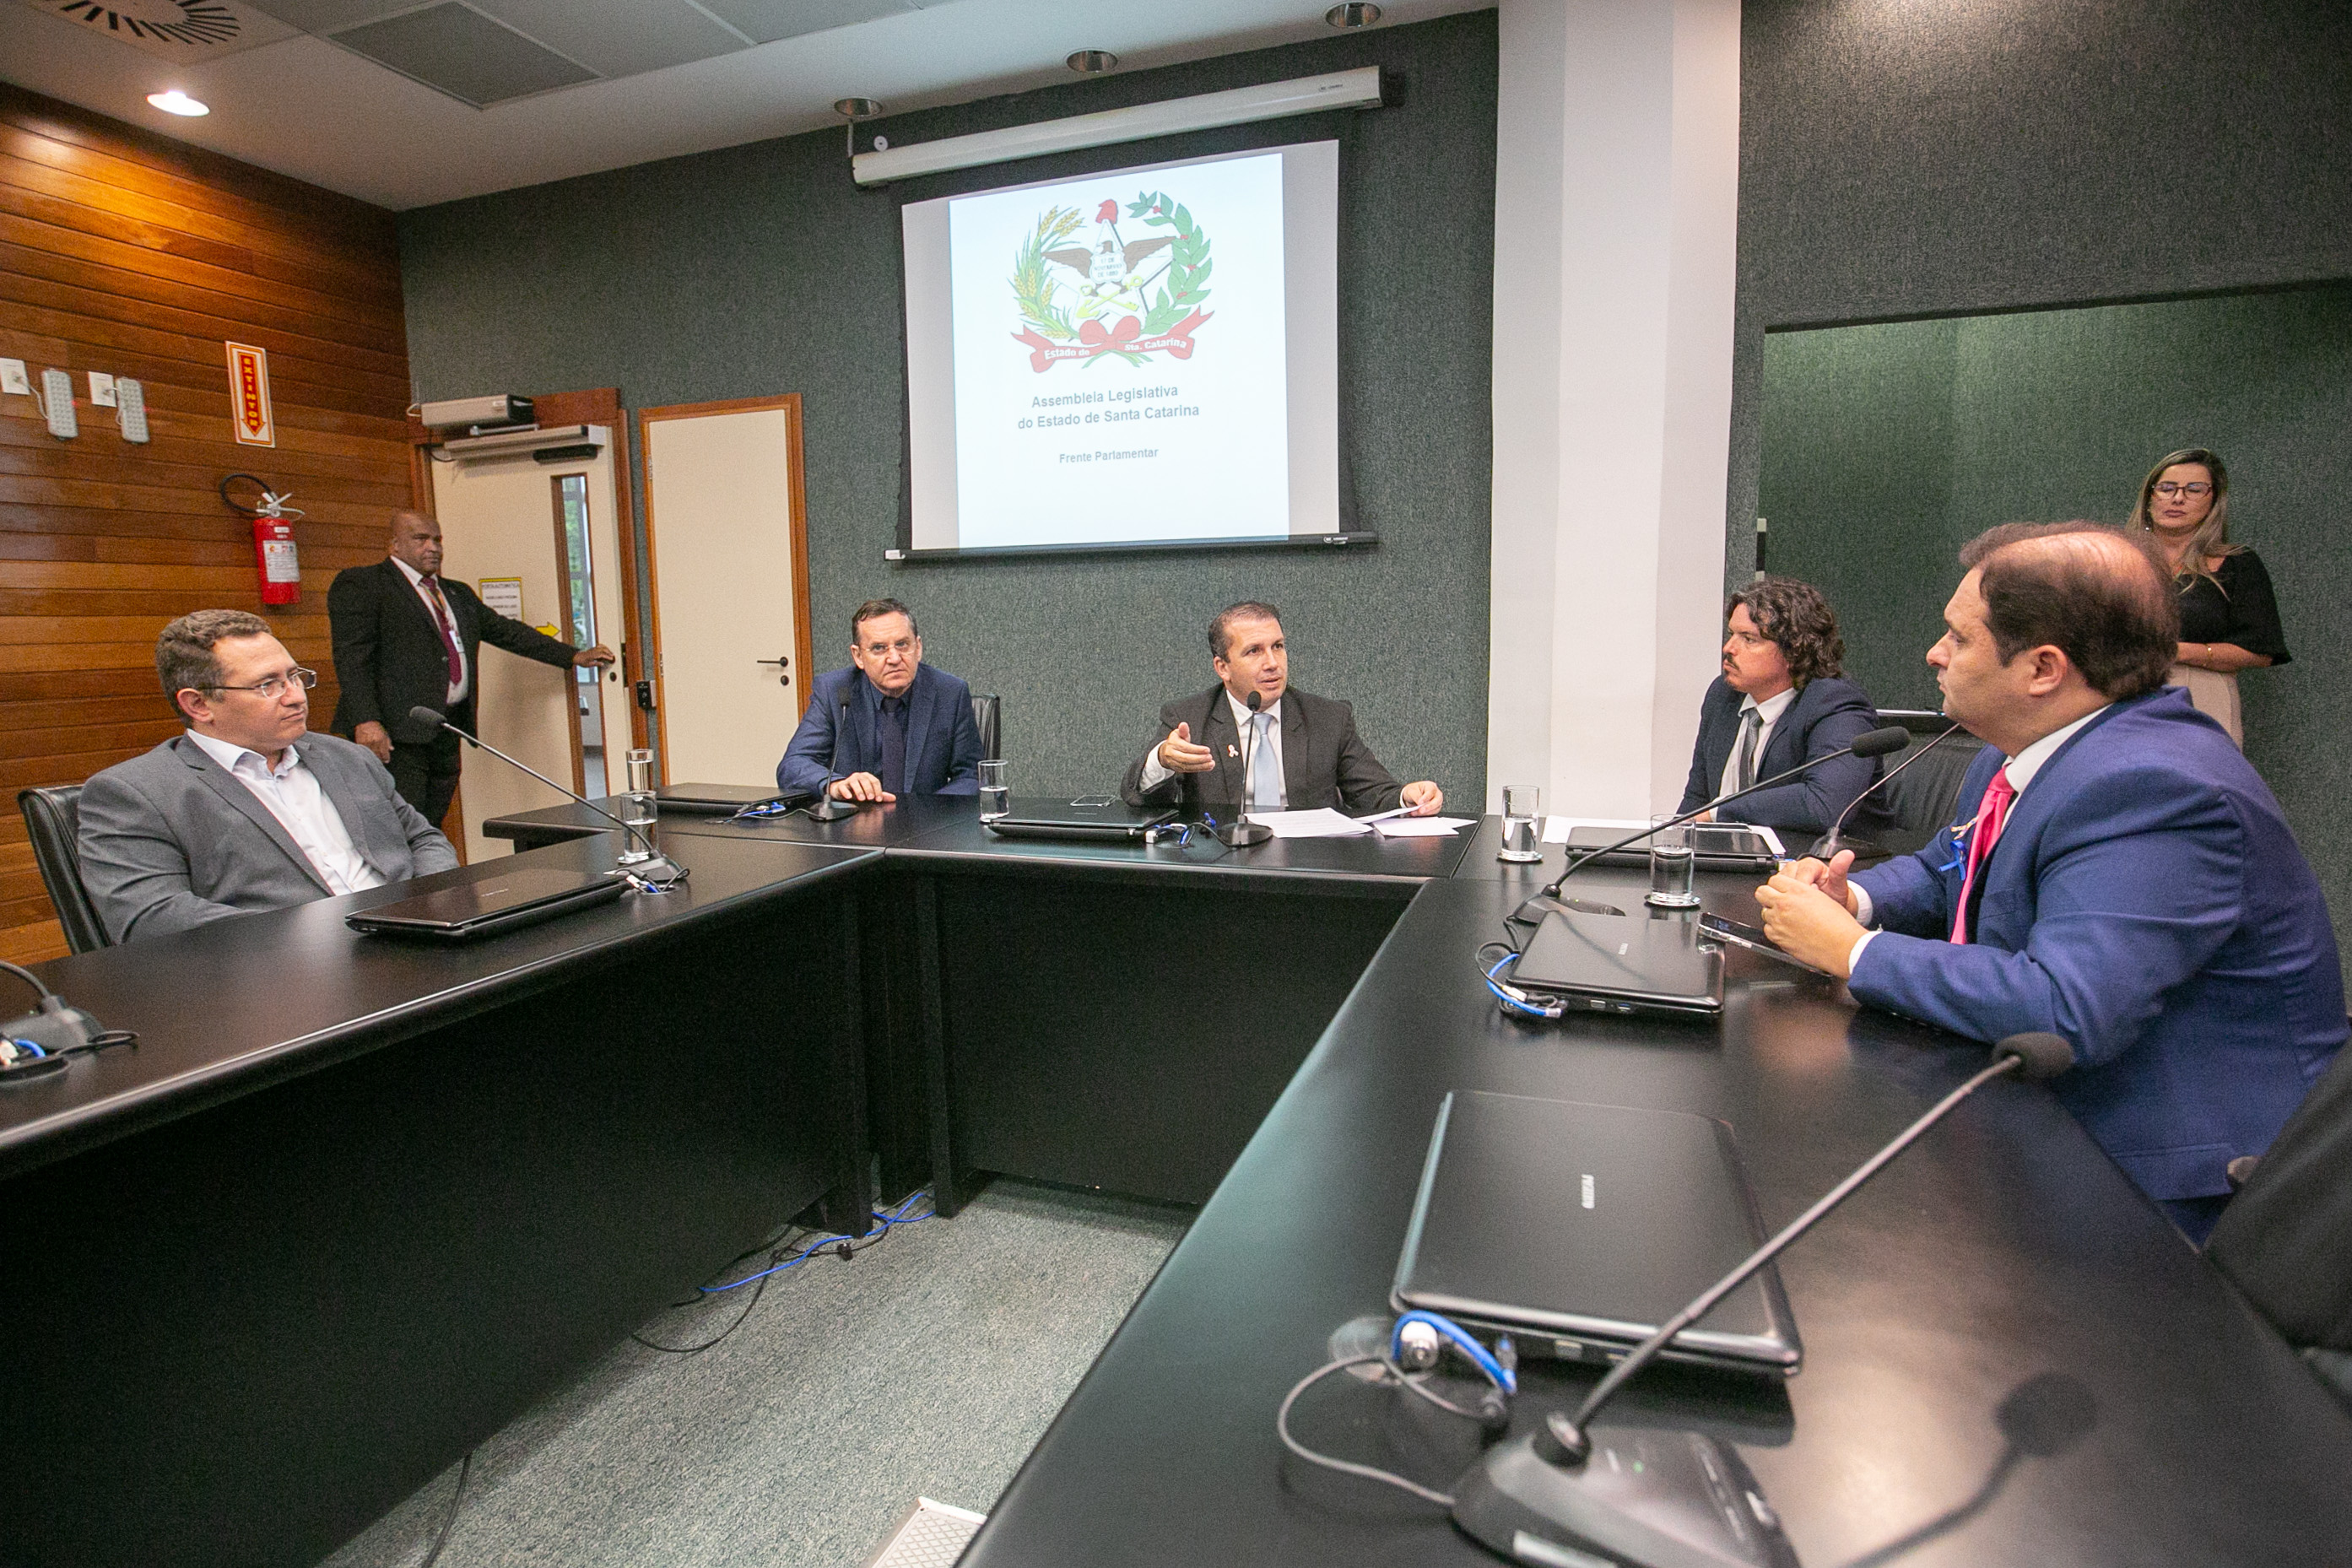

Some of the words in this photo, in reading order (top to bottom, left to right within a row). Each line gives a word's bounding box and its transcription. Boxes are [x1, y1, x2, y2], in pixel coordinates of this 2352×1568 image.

[1044, 349, 1077, 360] Estado
[1144, 338, 1187, 349] Catarina
[243, 358, 258, 427] EXTINTOR
[1031, 391, 1104, 408] Assembleia
[1108, 386, 1178, 403] Legislativa
[1018, 418, 1033, 429] do
[1037, 414, 1080, 428] Estado
[1084, 412, 1100, 424] de
[1104, 409, 1140, 423] Santa
[1144, 404, 1199, 419] Catarina
[1059, 452, 1092, 463] Frente
[1095, 448, 1159, 462] Parlamentar
